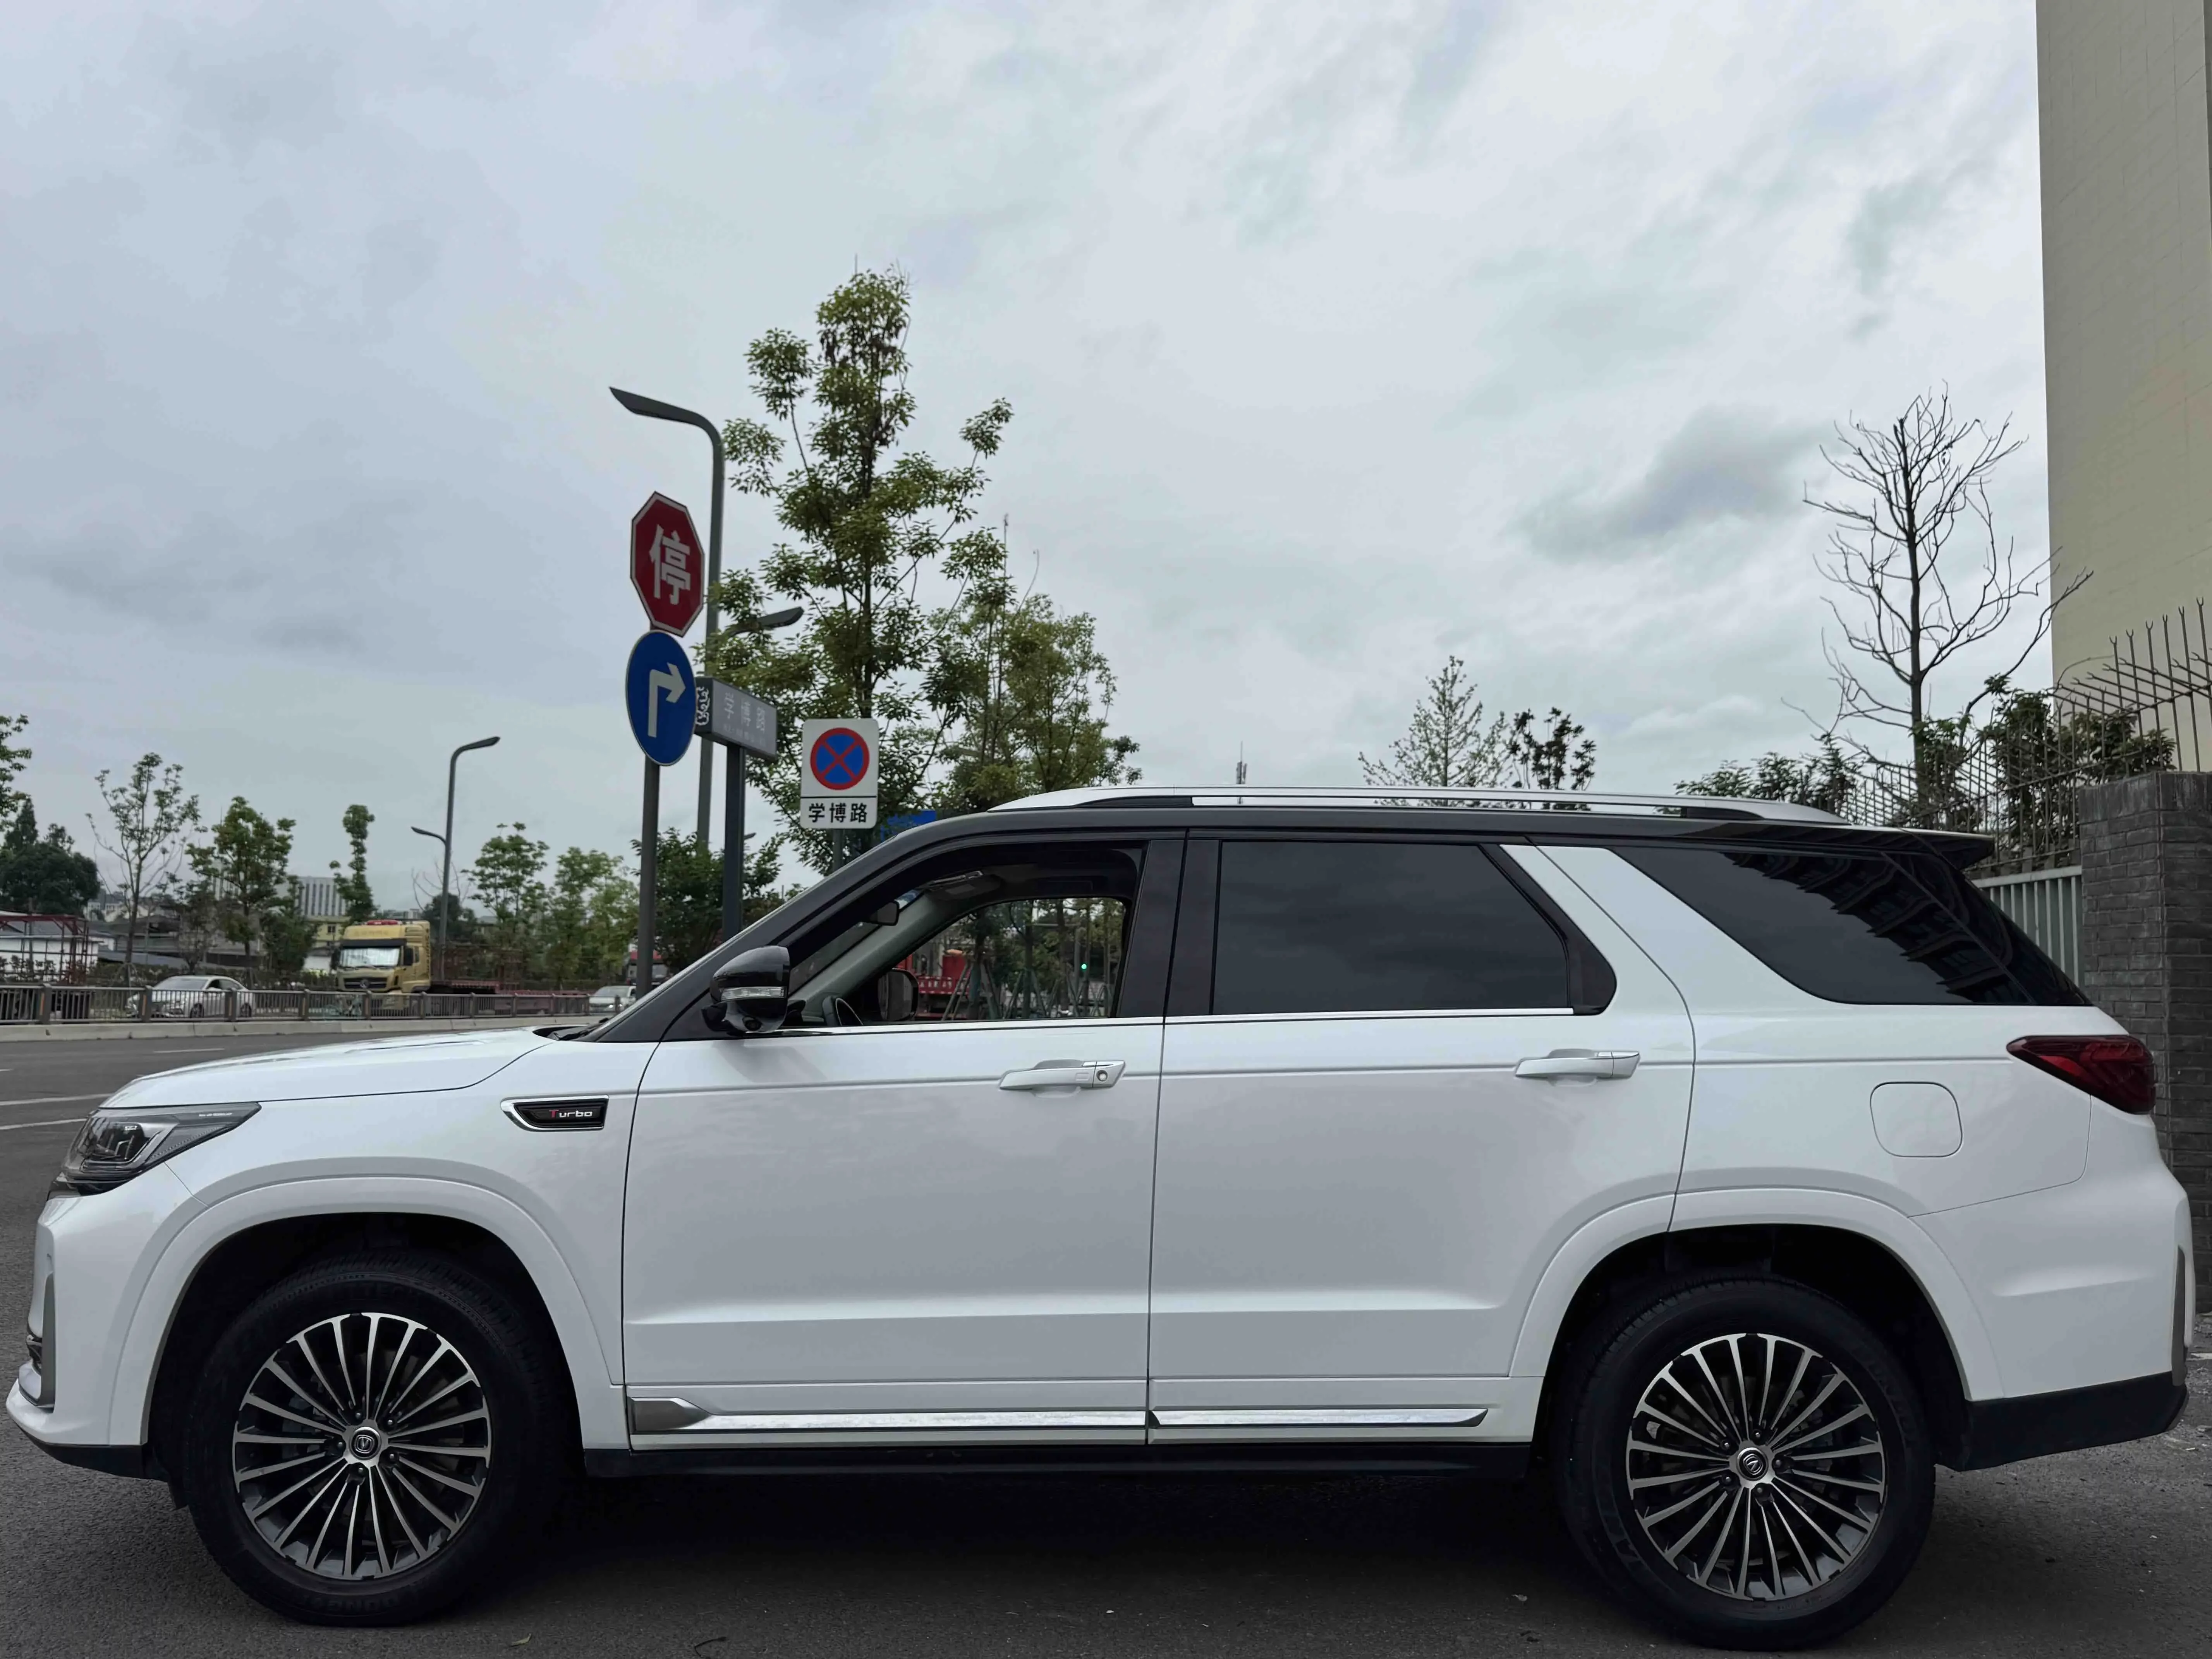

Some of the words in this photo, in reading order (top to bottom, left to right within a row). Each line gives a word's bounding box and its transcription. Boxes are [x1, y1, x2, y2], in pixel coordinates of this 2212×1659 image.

[649, 524, 690, 605] 停
[808, 802, 867, 823] 学博路
[549, 1109, 592, 1118] Turbo
